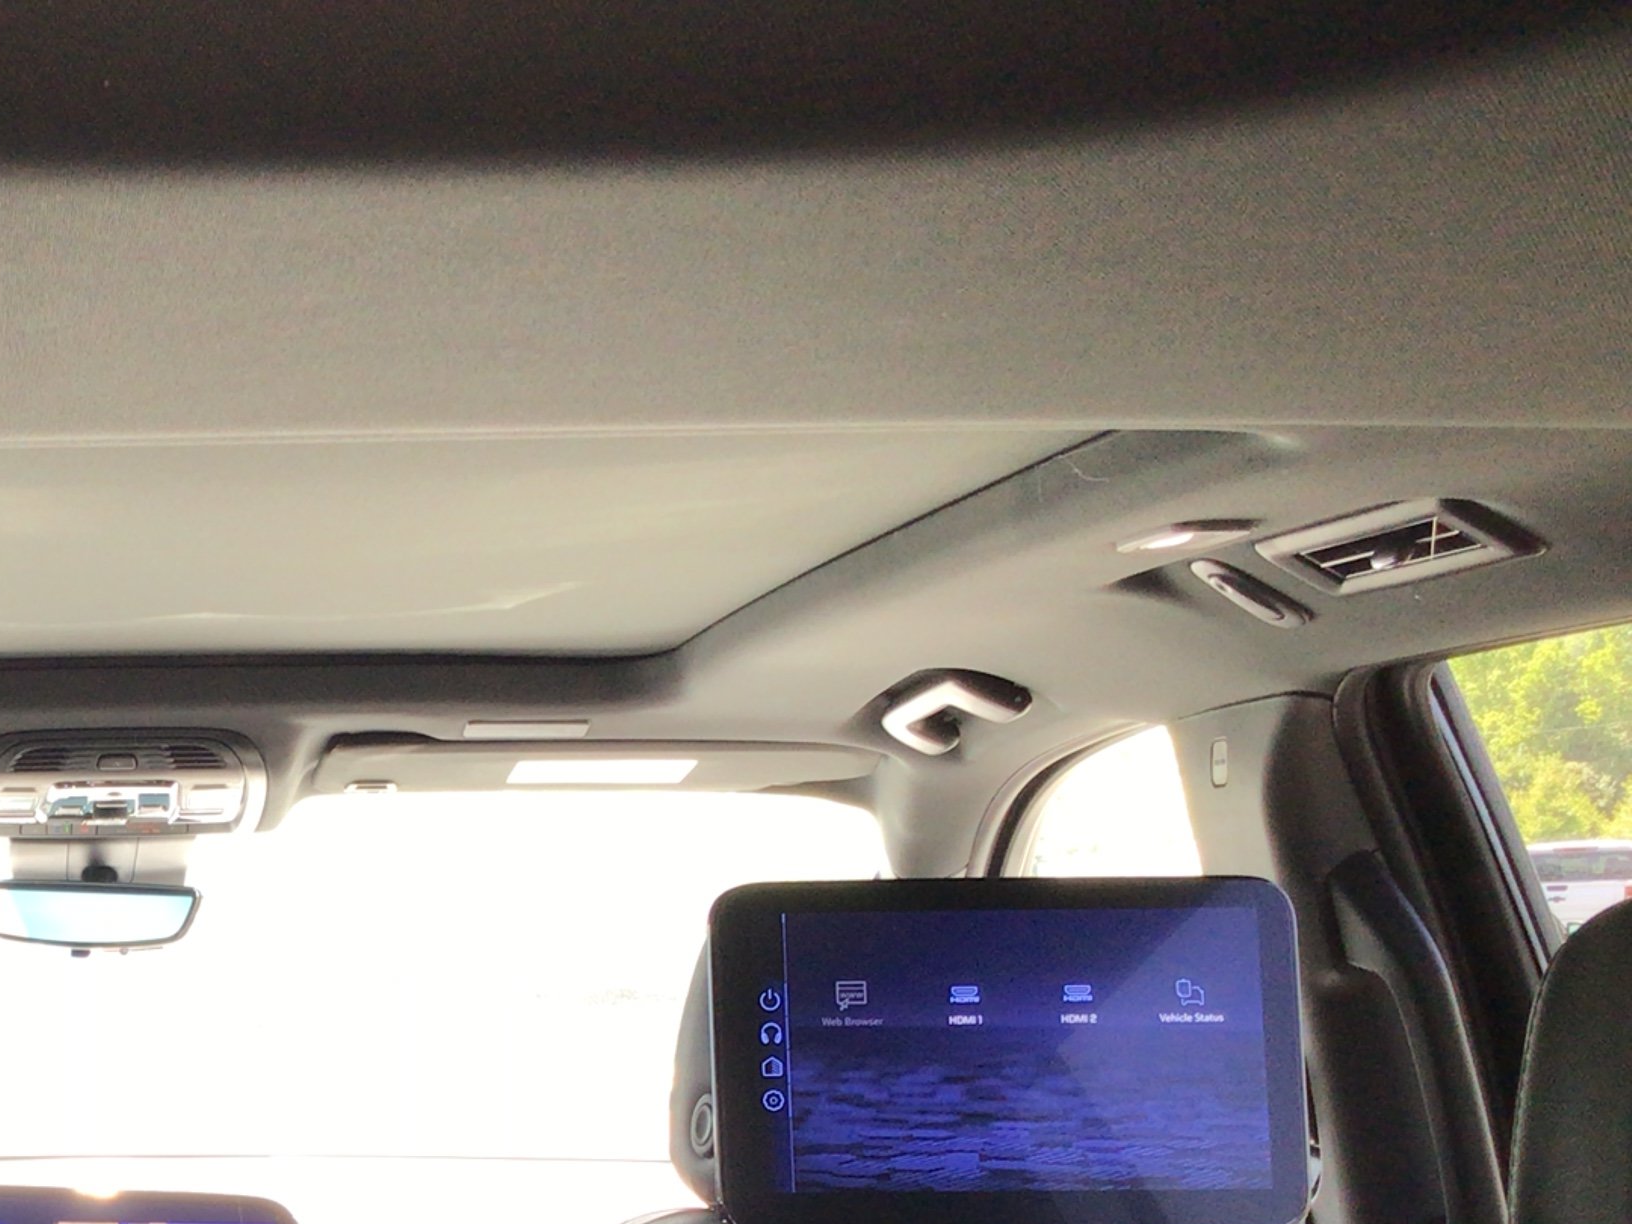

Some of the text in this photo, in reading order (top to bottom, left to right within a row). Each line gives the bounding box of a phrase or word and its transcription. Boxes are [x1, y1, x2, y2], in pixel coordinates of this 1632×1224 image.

[821, 1016, 883, 1026] Web Browser
[948, 1015, 977, 1025] HDMI
[1061, 1014, 1097, 1024] HDMI 2
[1159, 1013, 1225, 1023] Vehicle Status
